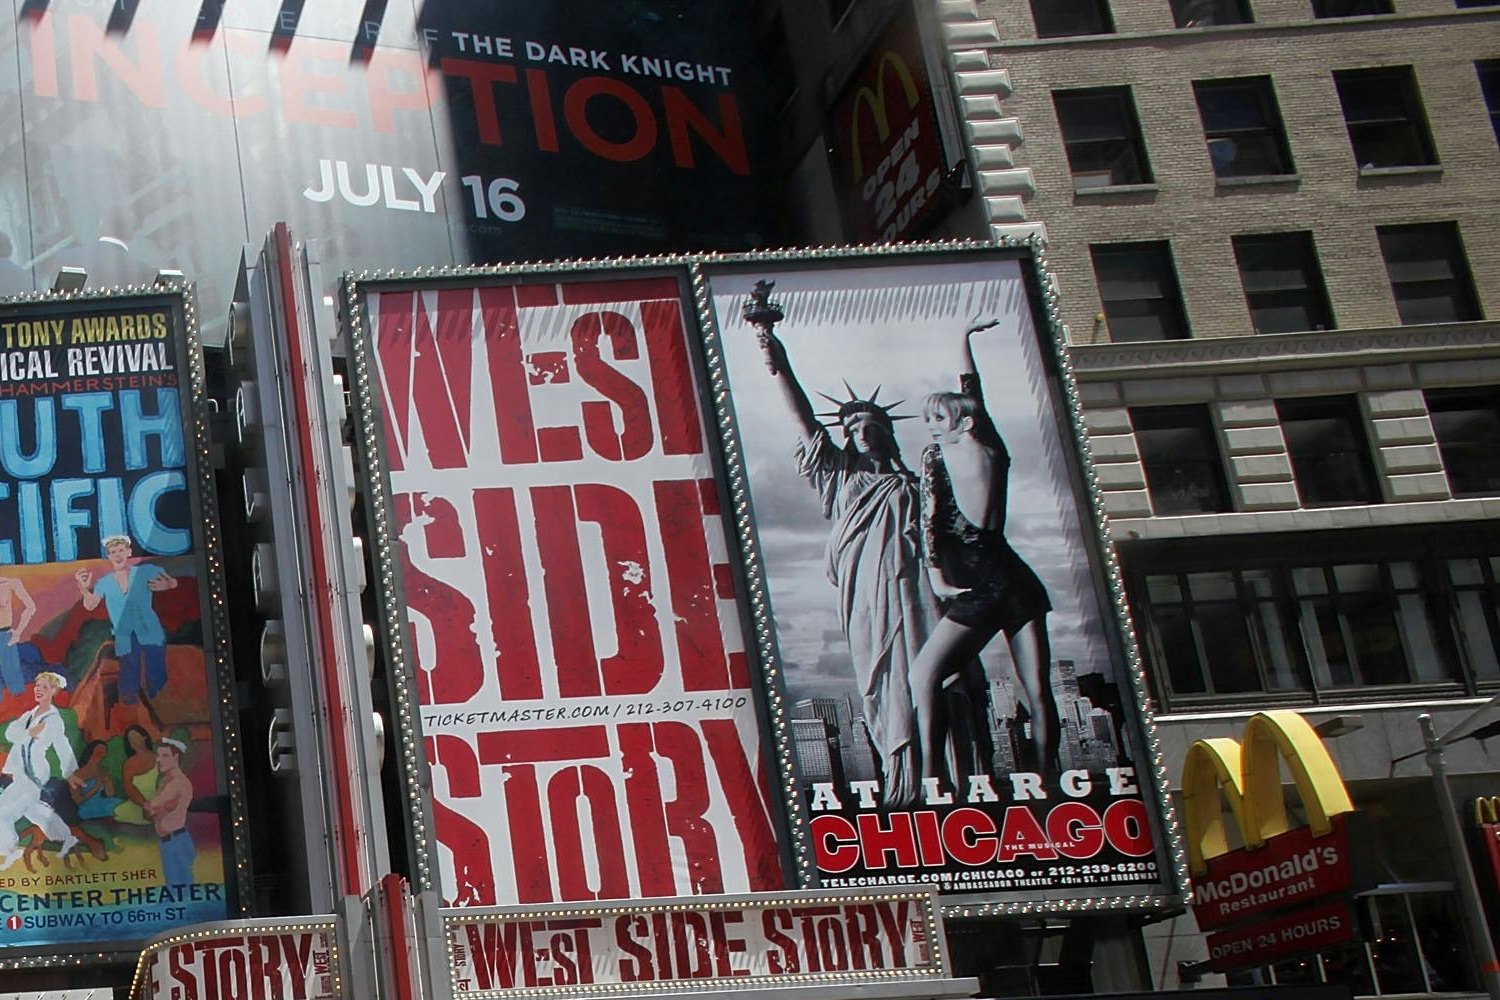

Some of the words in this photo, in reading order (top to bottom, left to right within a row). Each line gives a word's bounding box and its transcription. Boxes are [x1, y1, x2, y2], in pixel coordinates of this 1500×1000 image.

[451, 32, 512, 61] THE
[525, 40, 611, 71] DARK
[620, 53, 732, 86] KNIGHT
[28, 8, 752, 175] INCEPTION
[303, 157, 446, 214] JULY
[461, 173, 526, 223] 16
[1, 319, 65, 349] TONY
[72, 312, 168, 344] AWARDS
[67, 342, 174, 377] REVIVAL
[376, 278, 704, 470] WEST
[0, 373, 178, 397] HAMMERSTEIN'S
[393, 478, 754, 706] SIDE
[424, 704, 610, 728] TICKETMASTER.COM
[625, 697, 748, 716] 212-307-4100
[811, 781, 880, 811] AT
[922, 767, 1138, 807] LARGE
[424, 719, 784, 909] STORY
[809, 799, 1156, 873] CHICAGO
[1004, 843, 1025, 851] THE
[1028, 841, 1076, 850] MUSICAL
[21, 876, 40, 887] BY
[45, 872, 117, 886] BARTLETT
[122, 869, 157, 881] SHER
[113, 882, 222, 903] THEATER
[821, 868, 1025, 889] TELECHARGE.COM/CHICAGO
[1031, 870, 1045, 878] or
[1048, 861, 1158, 877] 212-239-6200
[953, 880, 1012, 891] AMBASSADOR
[1014, 878, 1053, 888] THEATRE
[1111, 872, 1159, 882] BROADWAY
[1194, 847, 1338, 904] McDonald's
[1220, 880, 1315, 916] Restaurant
[7, 914, 21, 930] 1
[24, 912, 97, 929] SUBWAY
[101, 911, 123, 925] TO
[127, 910, 161, 923] 66TH
[165, 908, 185, 922] ST
[1211, 939, 1254, 960] OPEN
[1258, 932, 1277, 948] 24
[1282, 916, 1340, 941] HOURS
[465, 917, 601, 990] WEST
[614, 911, 751, 981] SIDE
[762, 900, 909, 974] STORY
